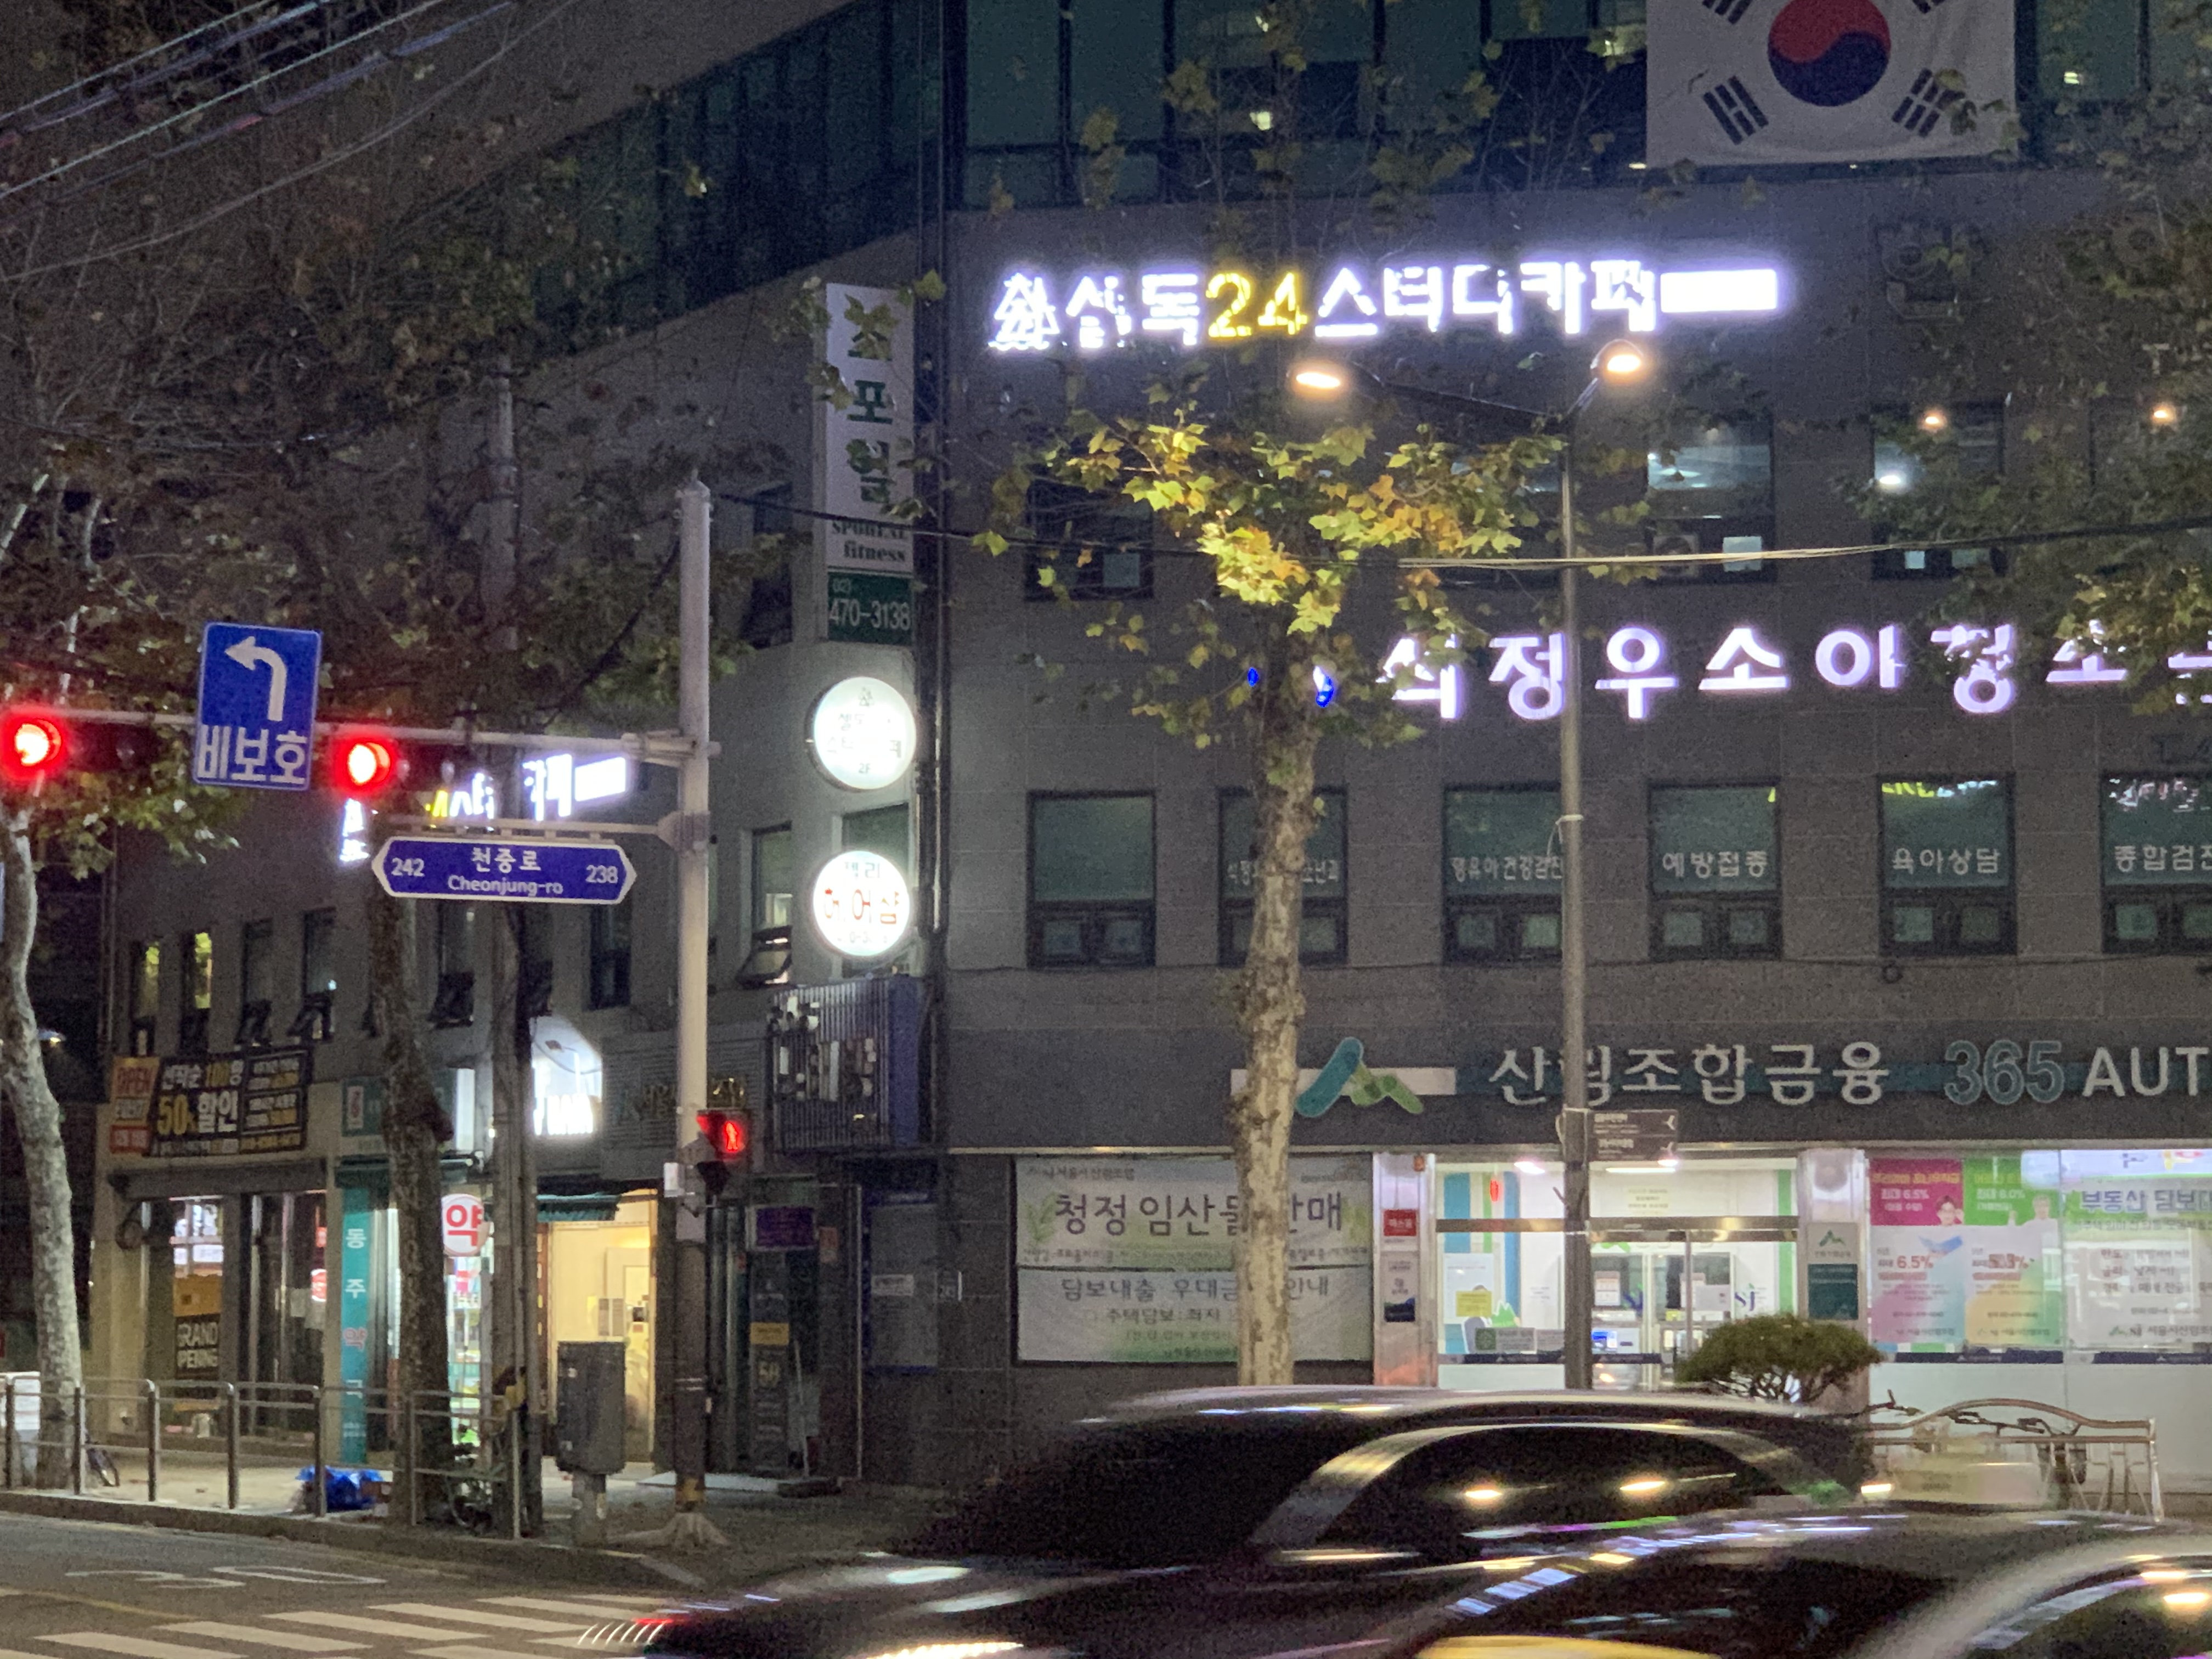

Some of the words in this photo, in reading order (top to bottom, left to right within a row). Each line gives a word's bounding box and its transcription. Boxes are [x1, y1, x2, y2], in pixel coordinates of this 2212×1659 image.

[197, 724, 308, 785] 비보호
[391, 857, 425, 878] 242
[471, 847, 541, 873] 천중로
[1662, 850, 1768, 878] 예방접종
[1893, 848, 2000, 875] 육아상담
[448, 874, 563, 897] Cheonjung-ro
[585, 865, 618, 885] 238
[1944, 1040, 2064, 1105] 365
[198, 1090, 239, 1133] 할인
[2081, 1189, 2148, 1214] 부동산
[446, 1204, 484, 1247] 약
[1897, 1255, 1934, 1269] 6.5%
